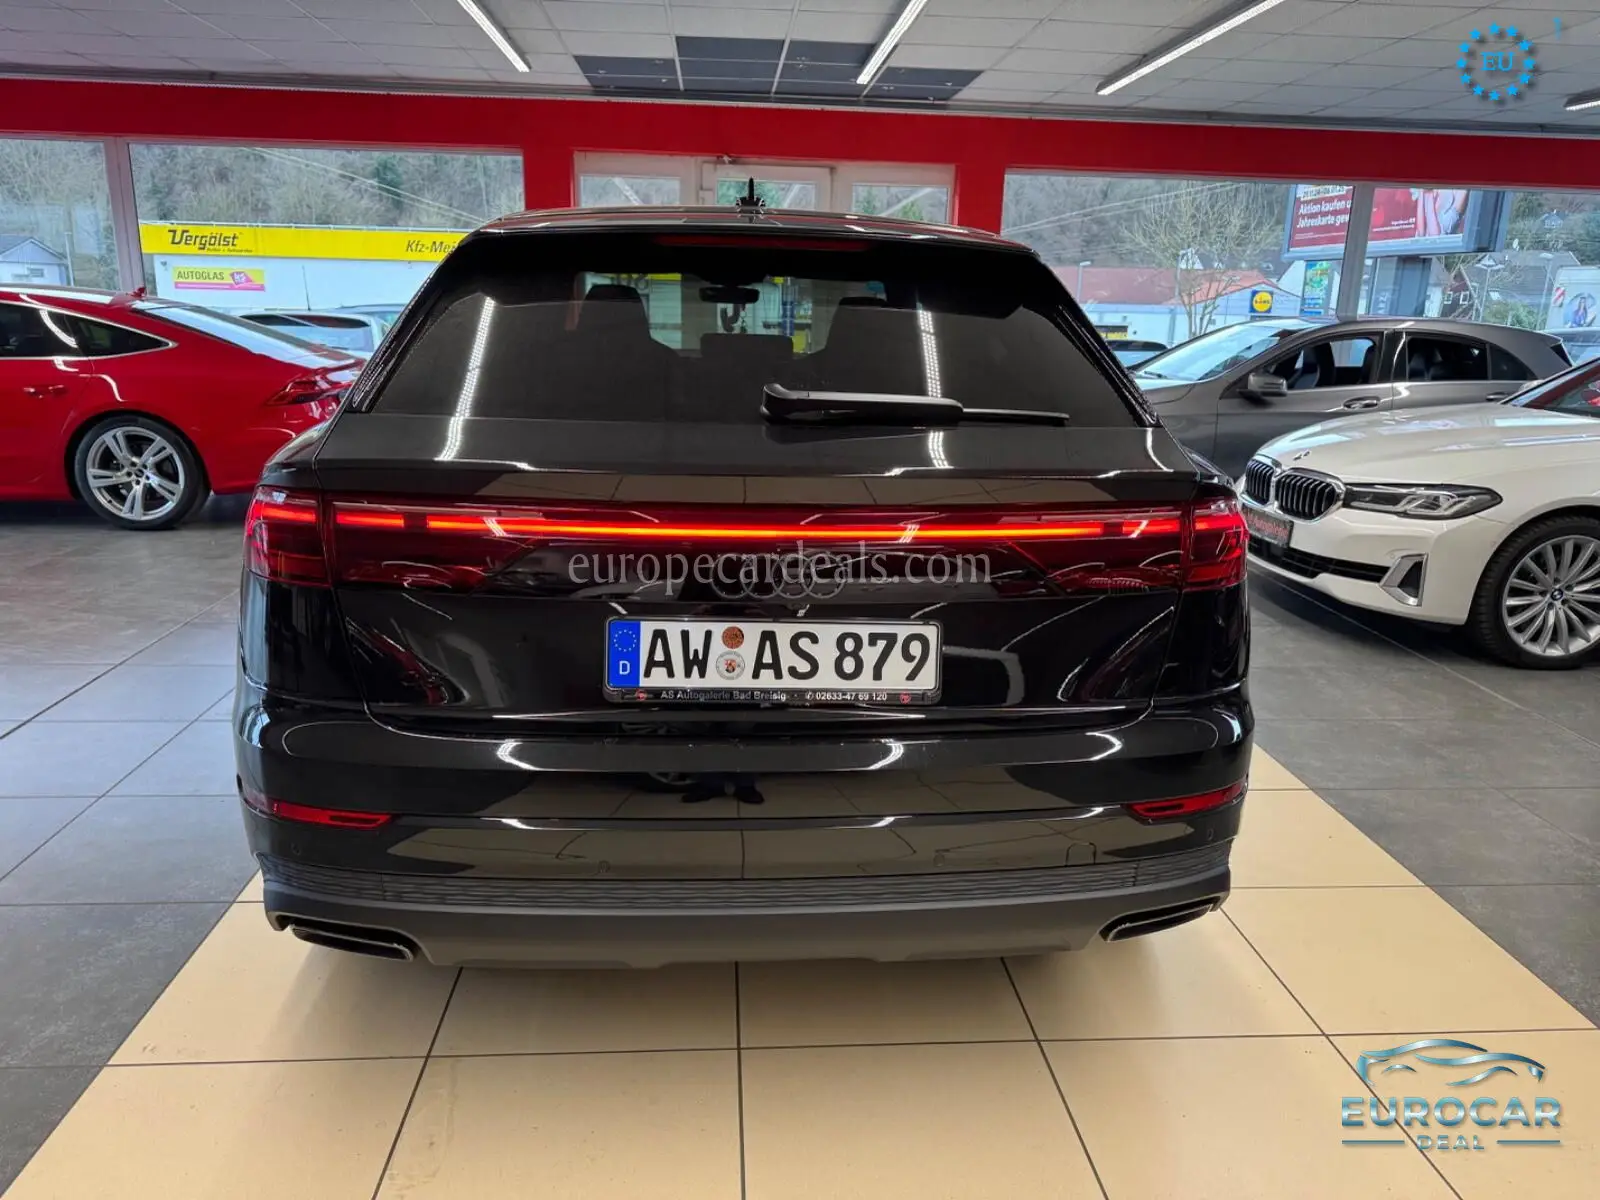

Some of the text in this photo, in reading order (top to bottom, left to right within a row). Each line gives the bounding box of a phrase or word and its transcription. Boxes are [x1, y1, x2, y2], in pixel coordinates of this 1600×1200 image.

[1299, 202, 1321, 215] Aktion
[1321, 199, 1346, 212] kaufen
[168, 229, 239, 251] Vergölst
[177, 270, 225, 281] AUTOGLAS
[643, 629, 931, 681] AW AS 879
[619, 660, 631, 675] D
[660, 690, 675, 699] AS
[677, 690, 730, 702] Autogalerie
[733, 690, 751, 700] Bad
[872, 692, 888, 701] 120
